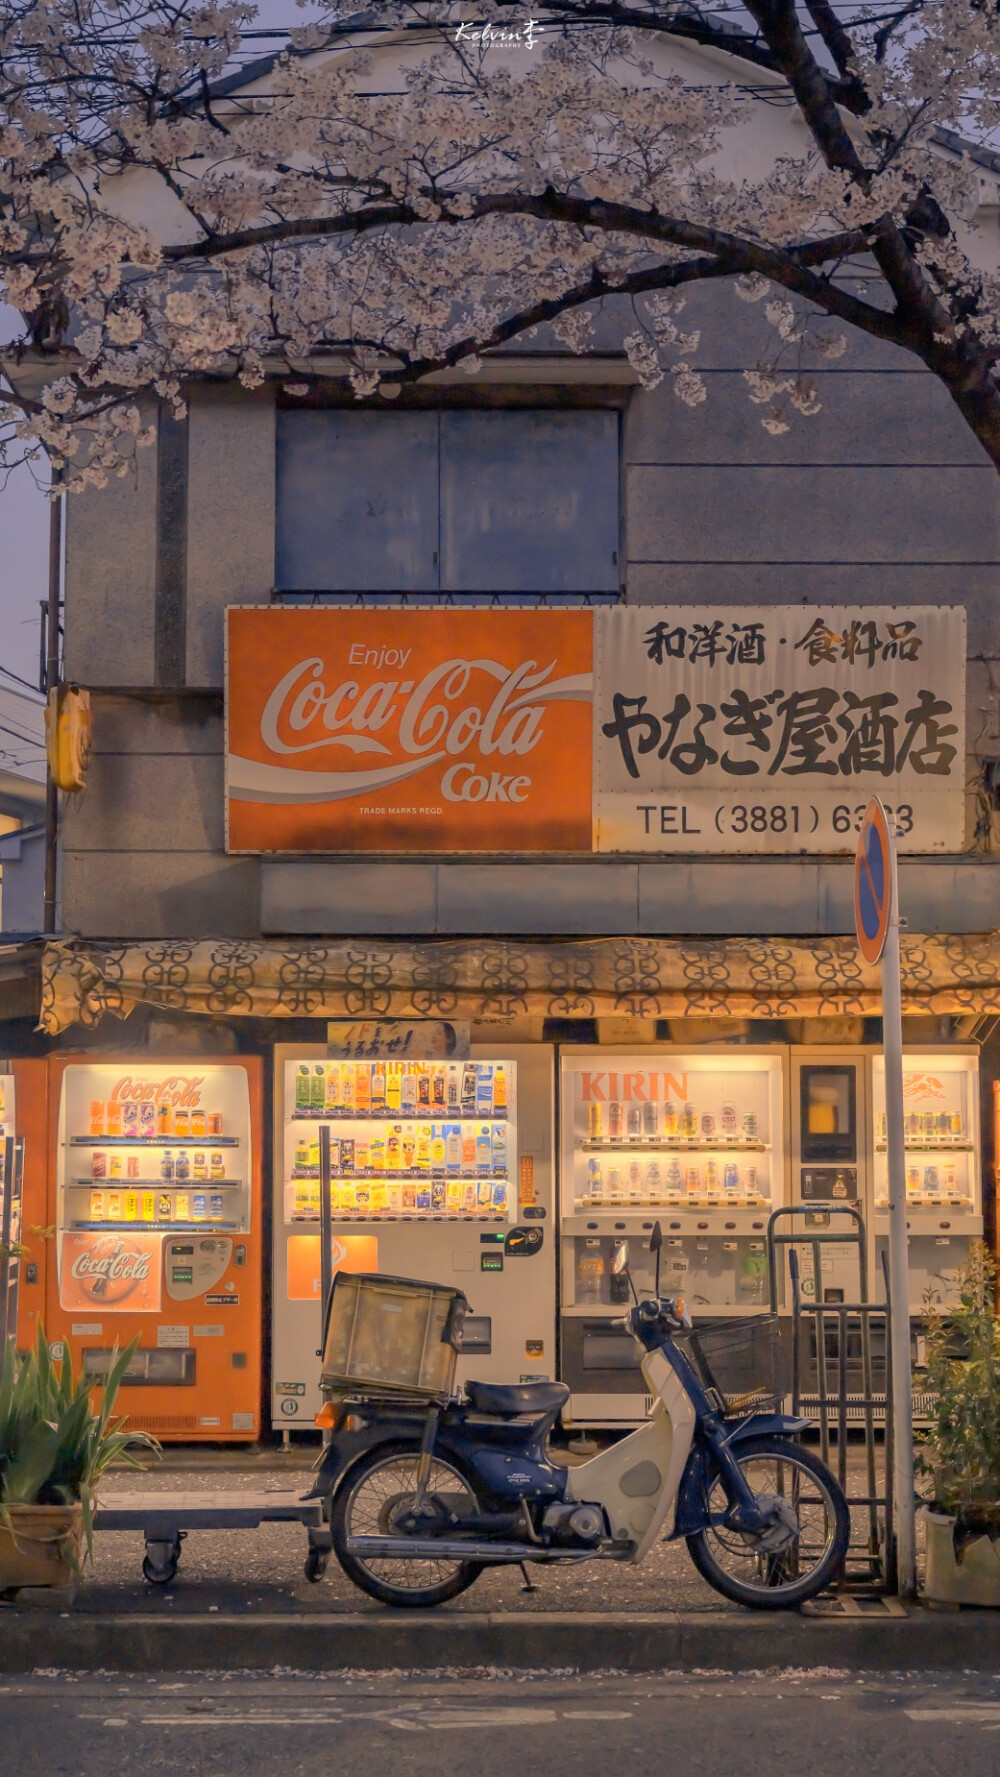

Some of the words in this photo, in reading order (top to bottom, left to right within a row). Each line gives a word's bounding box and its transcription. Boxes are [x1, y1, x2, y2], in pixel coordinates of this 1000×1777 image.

[348, 643, 412, 669] Enjoy
[260, 656, 558, 756] Coca-Cola
[602, 687, 959, 779] やなぎ屋酒店
[440, 762, 532, 803] Coke
[358, 806, 386, 815] TRADE
[388, 806, 417, 815] MARKS
[419, 806, 445, 815] REGD.
[636, 805, 701, 834] TEL
[714, 804, 820, 835] (3881)
[376, 1062, 426, 1075] KIRIN
[111, 1075, 206, 1108] Coca-Cola
[581, 1072, 688, 1102] KIRIN
[71, 1252, 153, 1281] Coca-Cola
